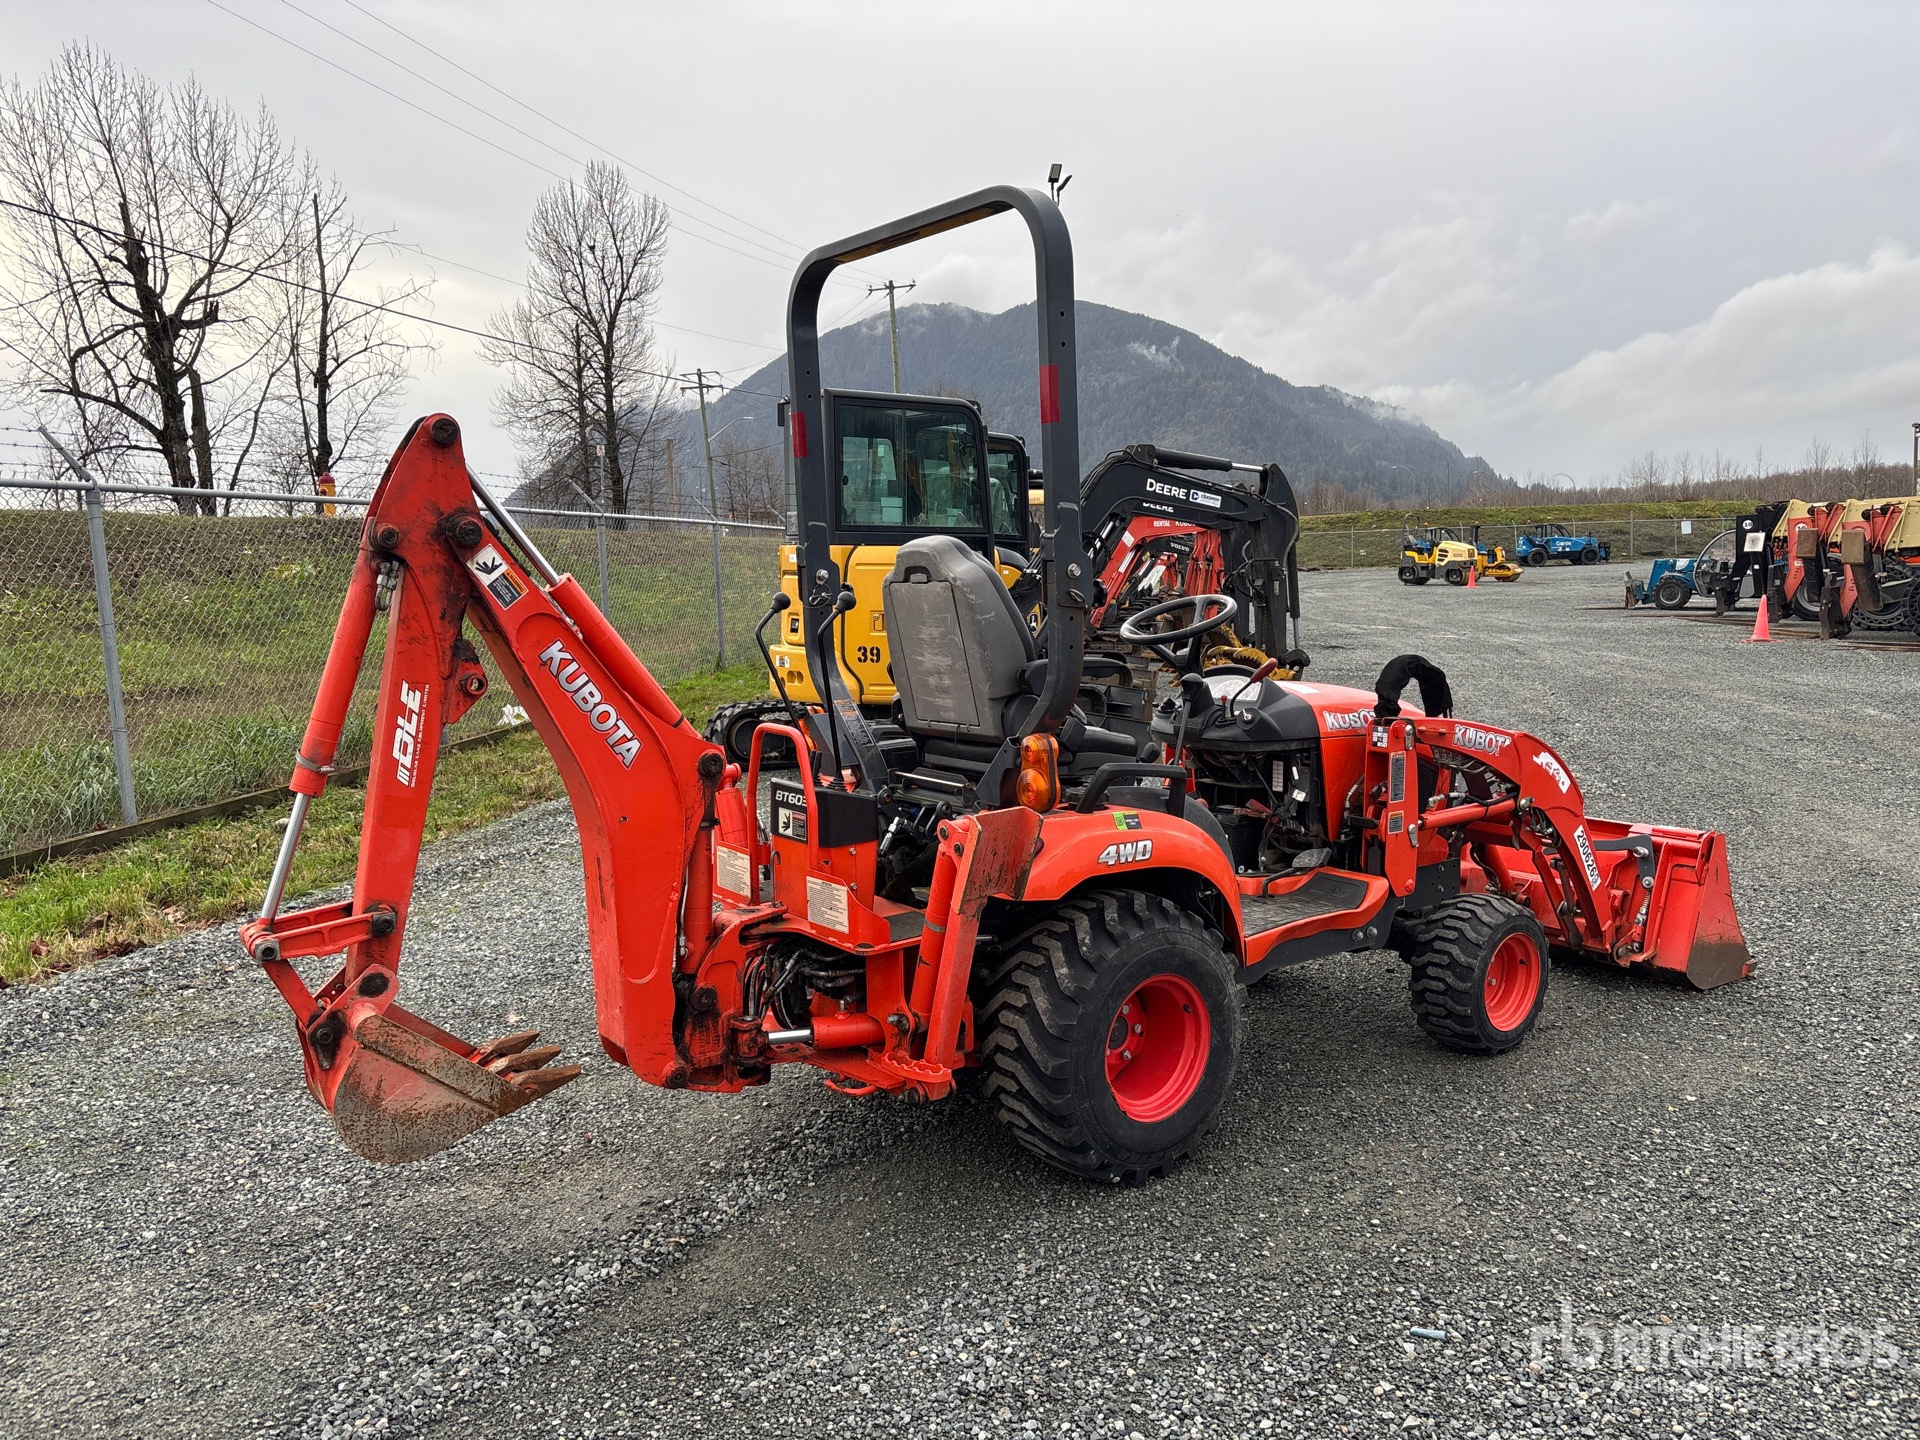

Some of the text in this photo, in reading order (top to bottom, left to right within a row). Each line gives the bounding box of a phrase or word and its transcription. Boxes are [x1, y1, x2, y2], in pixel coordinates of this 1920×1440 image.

[1146, 478, 1187, 500] DEERE
[857, 645, 881, 664] 39
[540, 638, 643, 770] KUBOTA
[392, 680, 421, 770] DLE
[1453, 724, 1511, 756] KUBOT
[1098, 839, 1153, 866] 4WD
